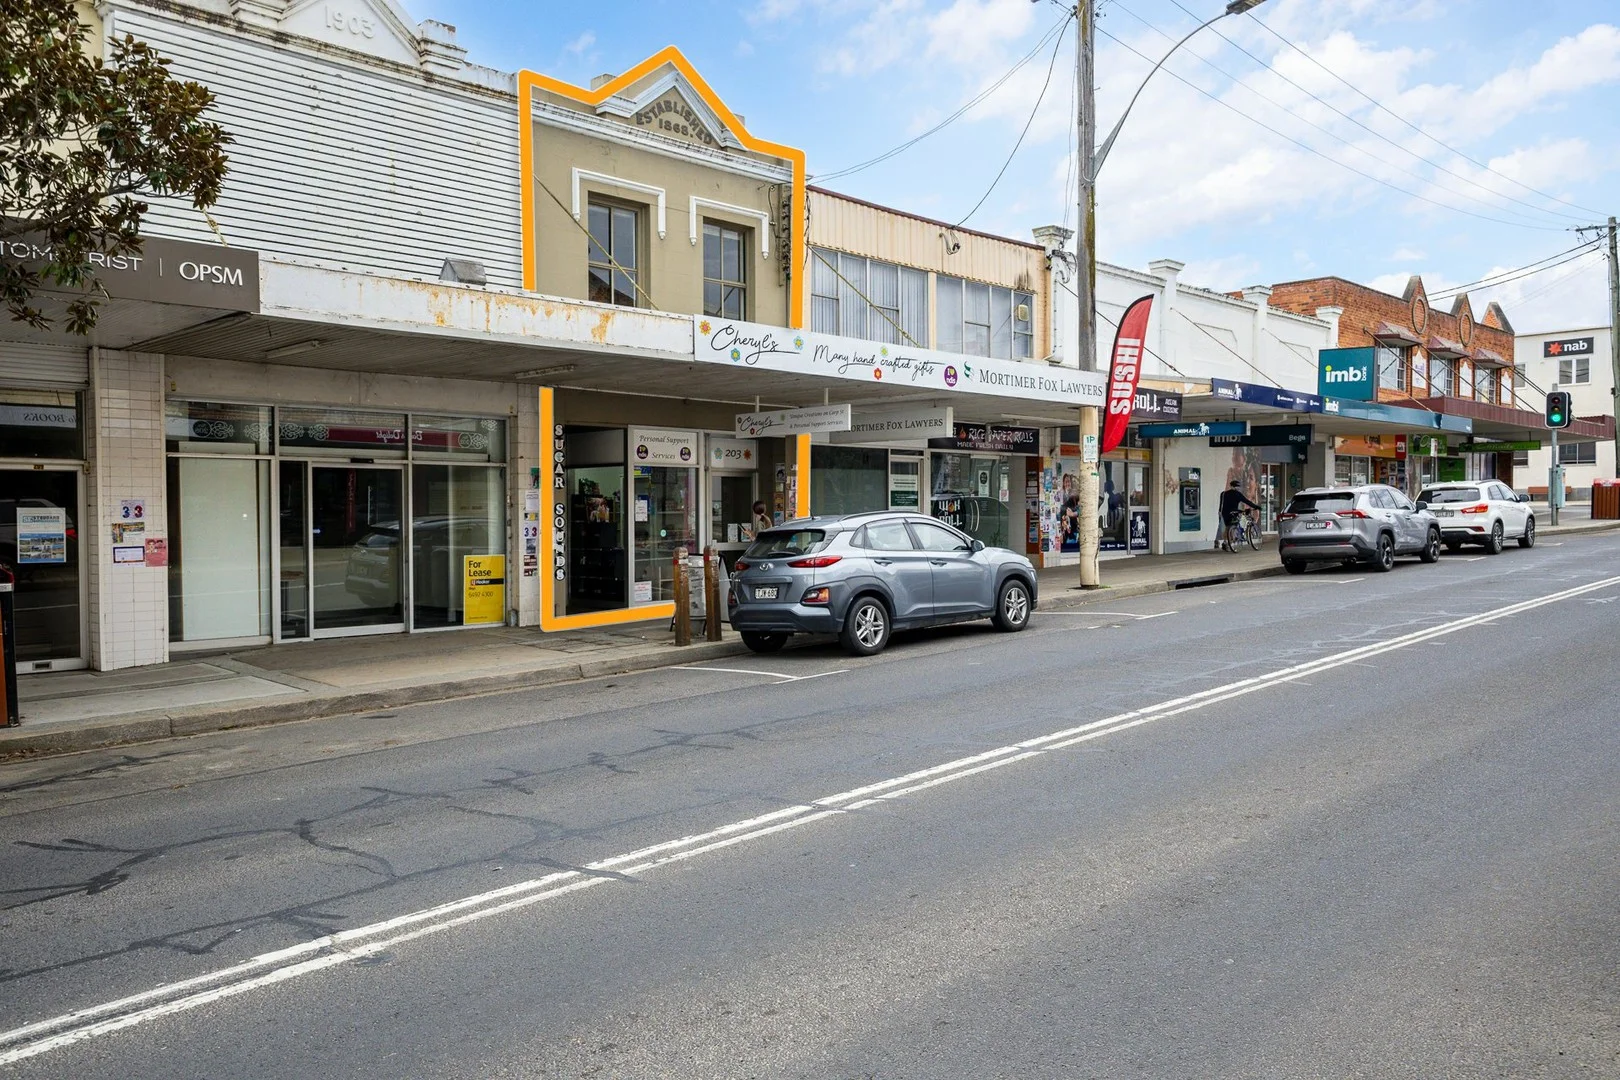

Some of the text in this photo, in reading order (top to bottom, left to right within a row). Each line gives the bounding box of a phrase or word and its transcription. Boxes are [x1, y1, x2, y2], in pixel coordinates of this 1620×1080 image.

[636, 99, 713, 145] ESTABLISHED
[179, 261, 243, 286] OPSM
[711, 324, 800, 366] Cheryl's
[1563, 340, 1588, 352] nab
[813, 344, 940, 381] Many hand crafted gifts
[979, 369, 1103, 397] MORTIMER FOX LAWYERS
[1110, 338, 1141, 415] SUSHI
[1325, 364, 1362, 383] imb
[886, 421, 903, 431] FOX
[905, 418, 943, 429] LAWYERS
[639, 434, 689, 445] Personal Support
[651, 452, 676, 460] Services
[725, 448, 741, 459] 203
[554, 503, 565, 581] SOUNDS
[468, 560, 482, 569] For
[468, 569, 491, 577] Lease
